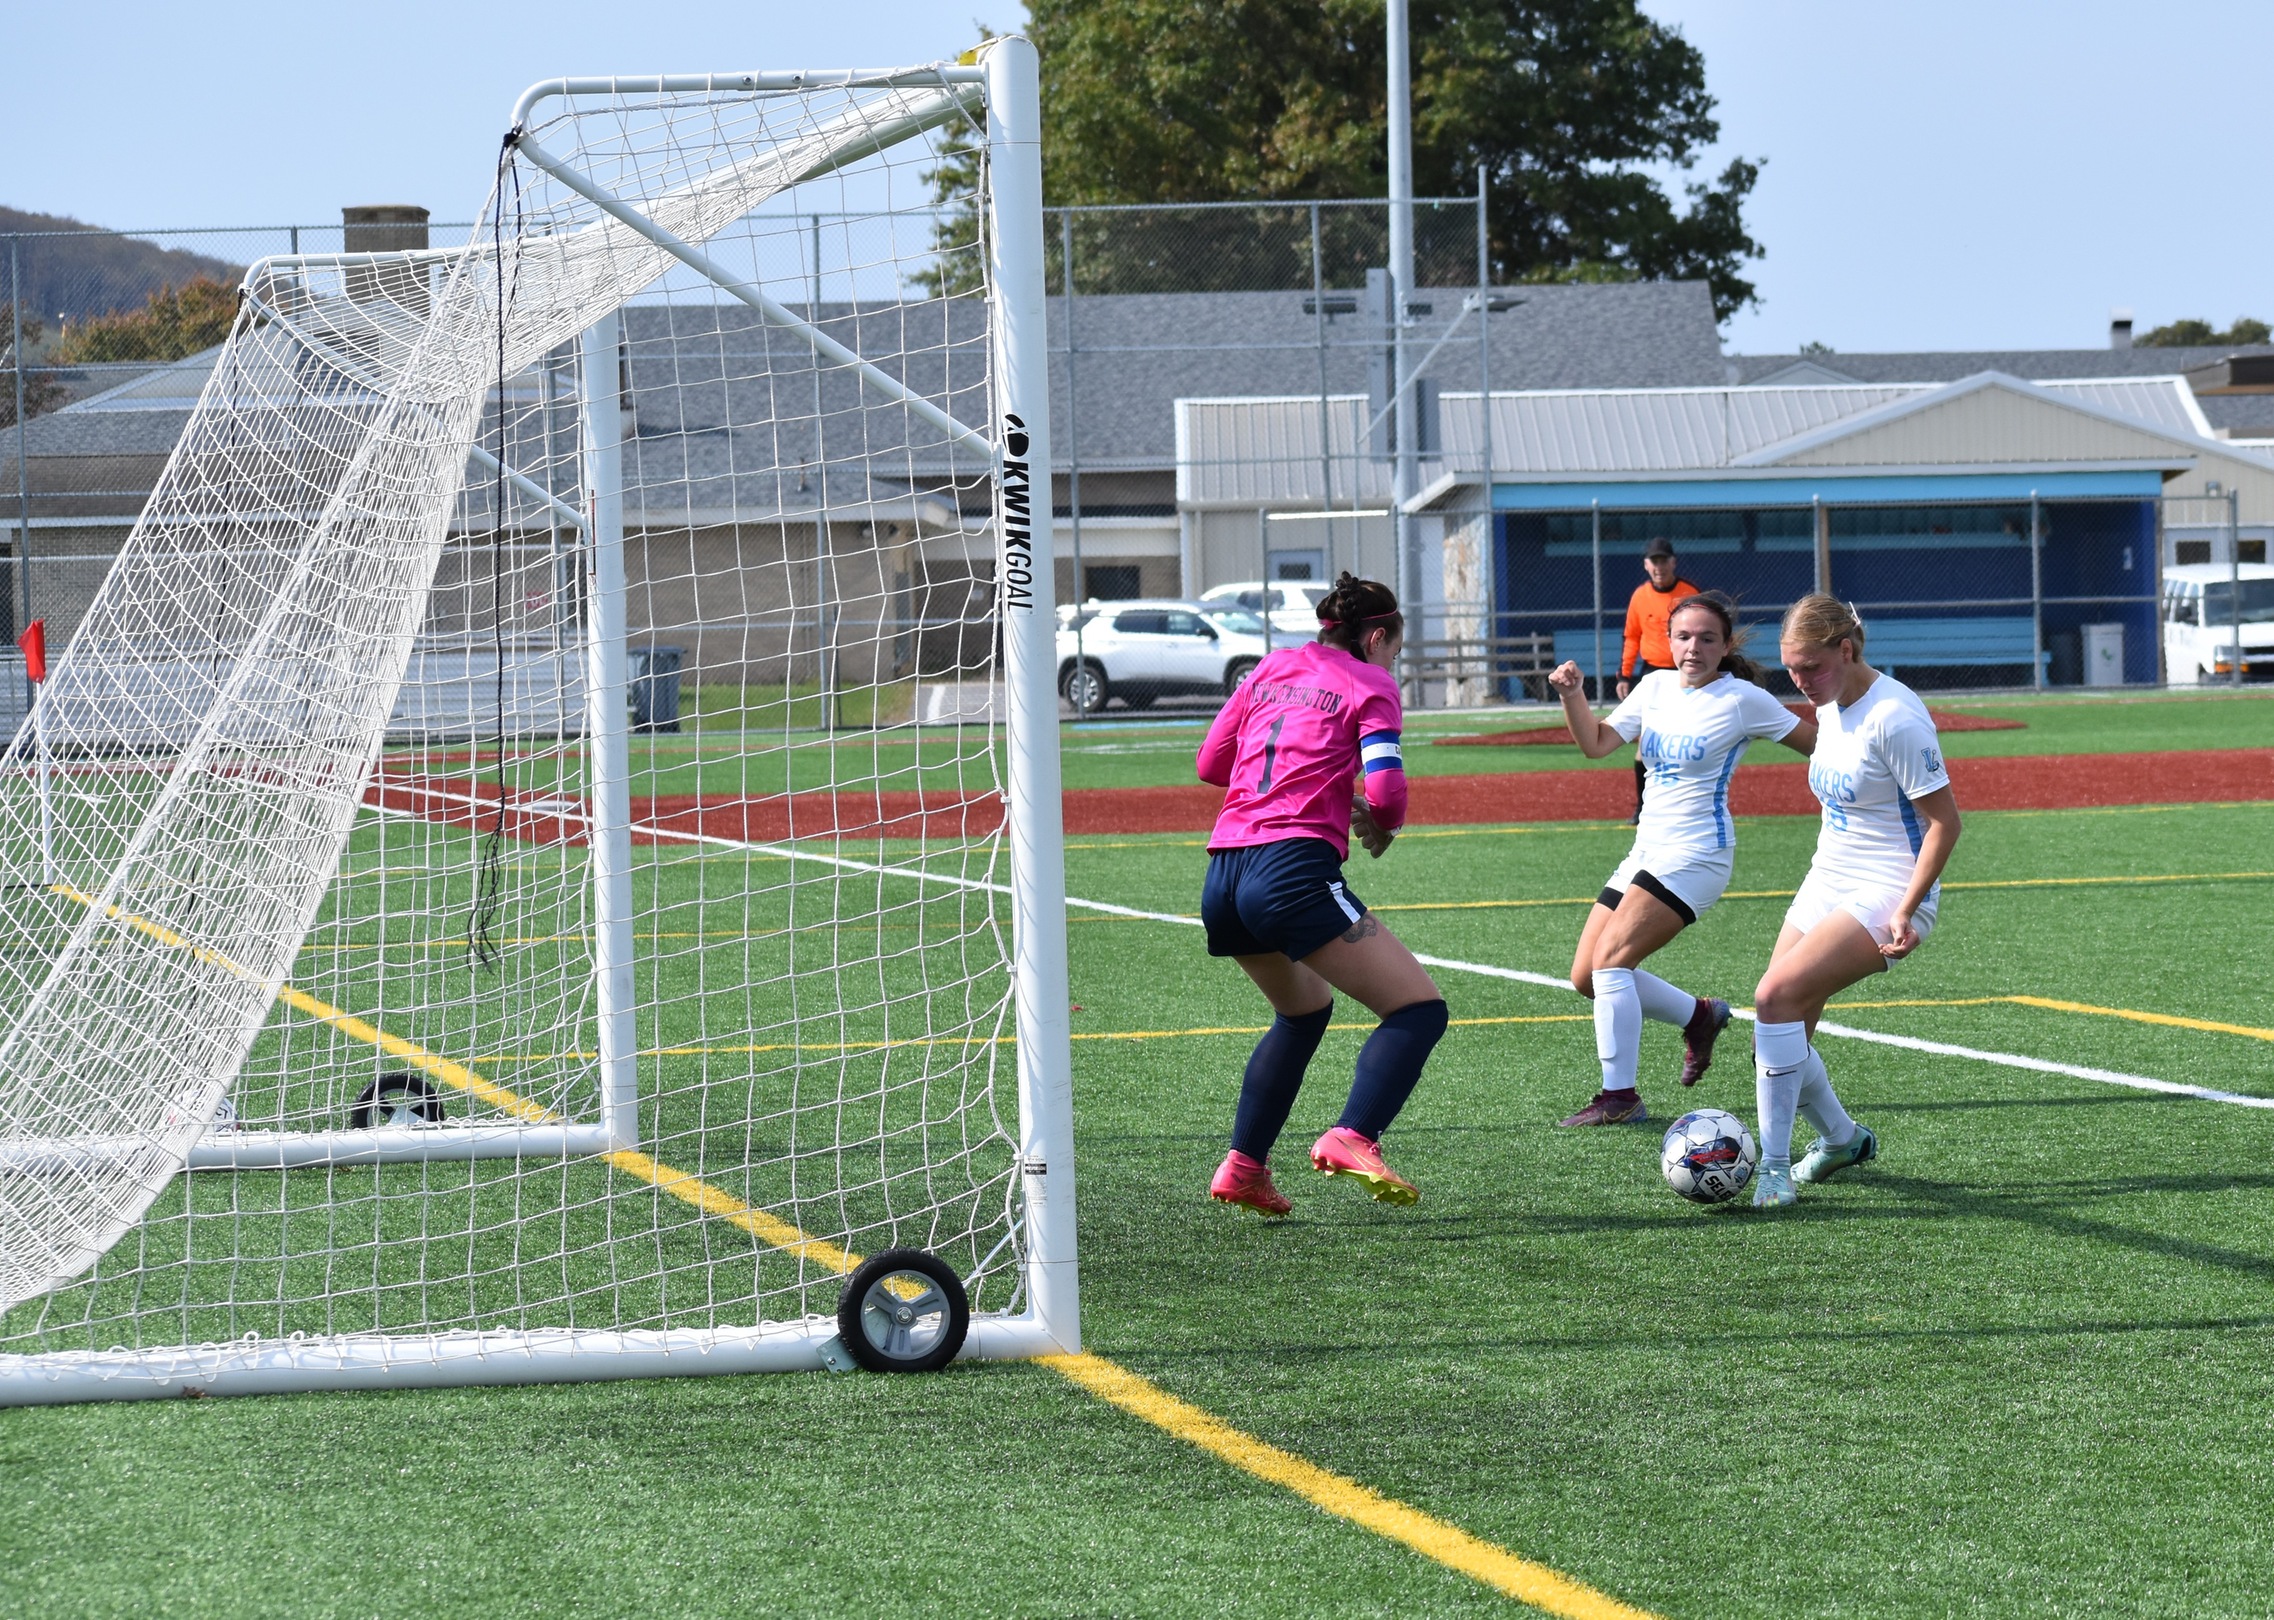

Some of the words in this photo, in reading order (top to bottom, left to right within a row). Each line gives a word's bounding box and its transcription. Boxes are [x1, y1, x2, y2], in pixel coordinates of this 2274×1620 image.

[1257, 714, 1286, 794] 1
[1642, 731, 1708, 762] AKERS
[1810, 762, 1857, 803] AKERS
